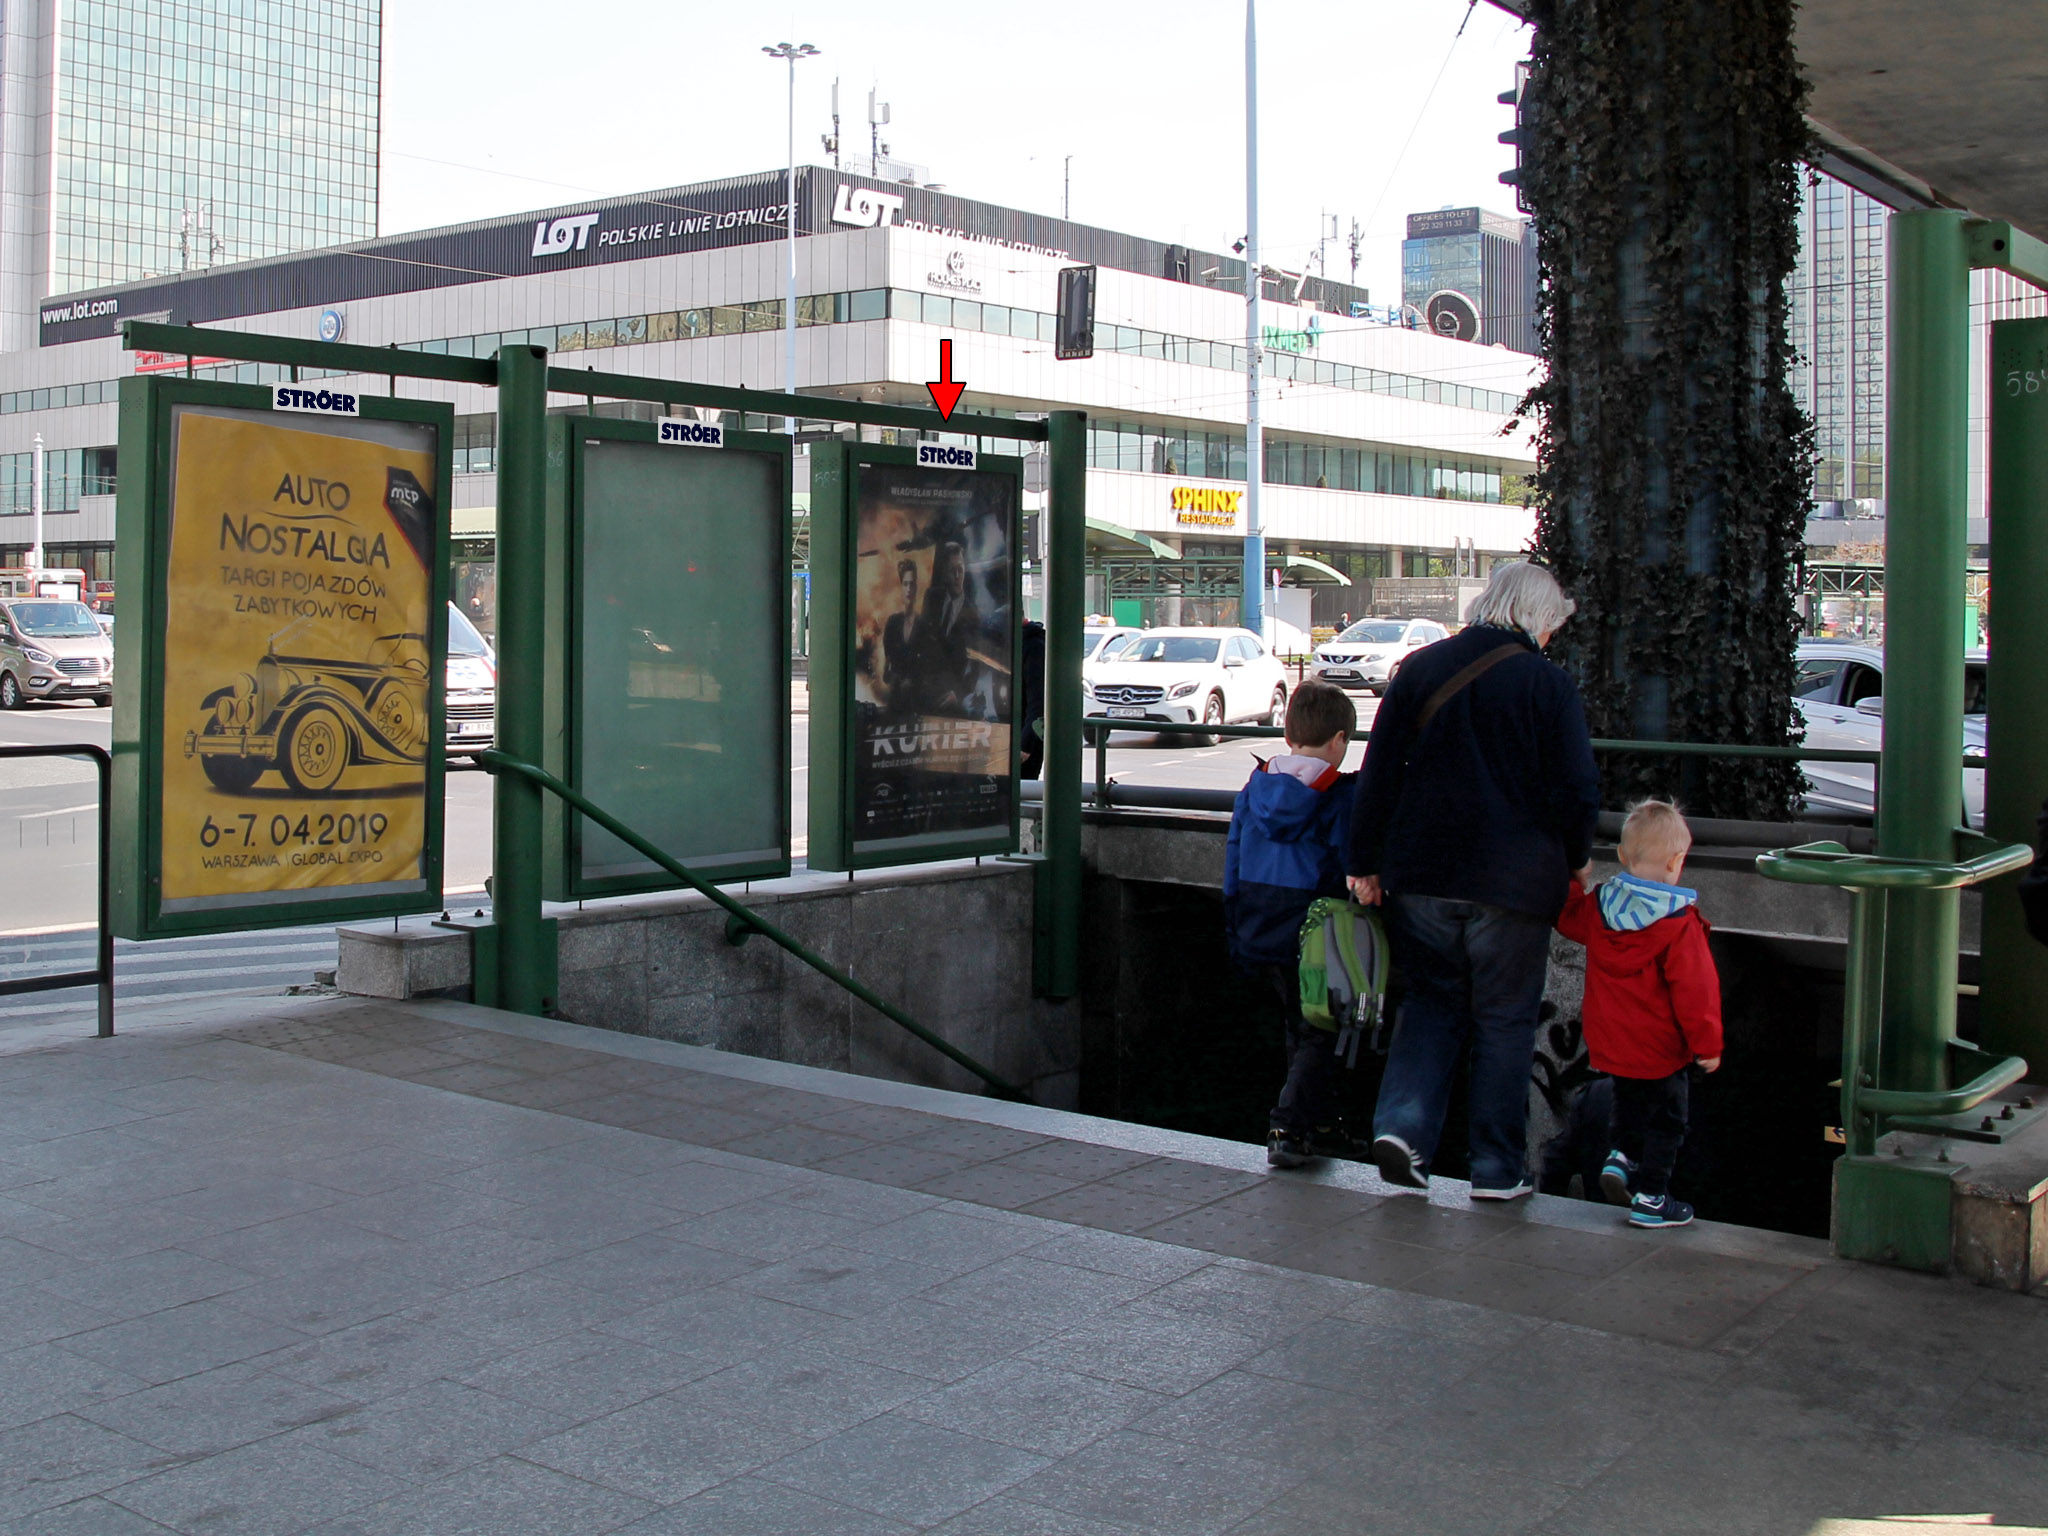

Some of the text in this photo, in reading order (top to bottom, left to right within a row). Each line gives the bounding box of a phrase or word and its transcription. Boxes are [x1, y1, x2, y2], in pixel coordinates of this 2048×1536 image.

[831, 184, 904, 227] LOT
[532, 212, 599, 257] LOT
[599, 222, 664, 247] POLSKIE
[668, 216, 712, 238] LINIE
[42, 299, 118, 325] www.lot.com
[276, 387, 356, 413] STRÖER
[660, 422, 721, 445] STRÖER
[919, 445, 974, 467] STRÖER
[273, 472, 350, 512] AUTO
[391, 487, 420, 504] mtp
[1171, 486, 1240, 512] SPHINX
[1177, 512, 1236, 527] RESTAURACJA
[219, 511, 391, 569] NOSTALGIA
[220, 565, 387, 599] TARGI POJAZDÓW
[234, 594, 377, 625] ZABYTKOWYCH
[872, 720, 992, 756] KURIER
[270, 812, 389, 847] 04.2019
[201, 850, 384, 870] WARSZAWA GLOBAL EXPO
